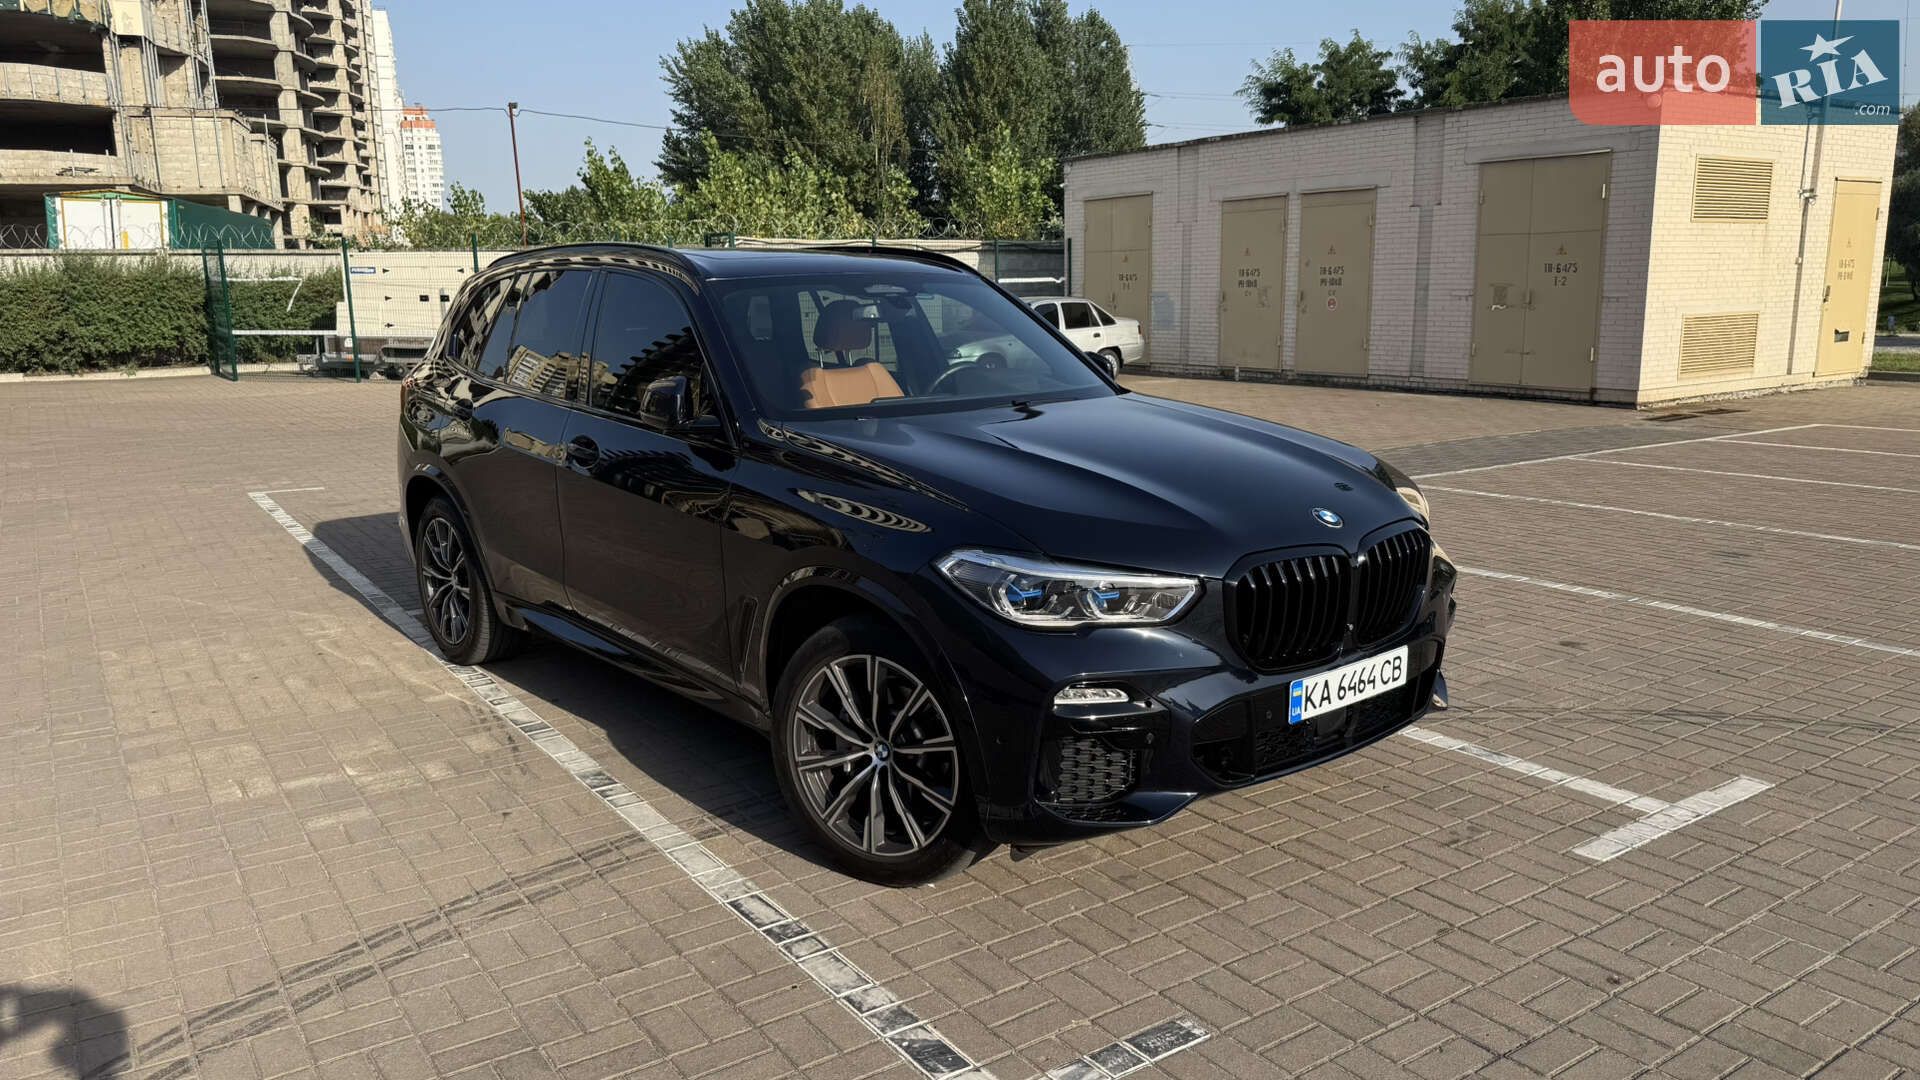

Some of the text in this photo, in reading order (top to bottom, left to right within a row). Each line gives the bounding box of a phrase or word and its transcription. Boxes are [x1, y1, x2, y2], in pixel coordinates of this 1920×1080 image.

[1304, 655, 1402, 712] KA 6464 CB
[1292, 705, 1301, 716] UA
